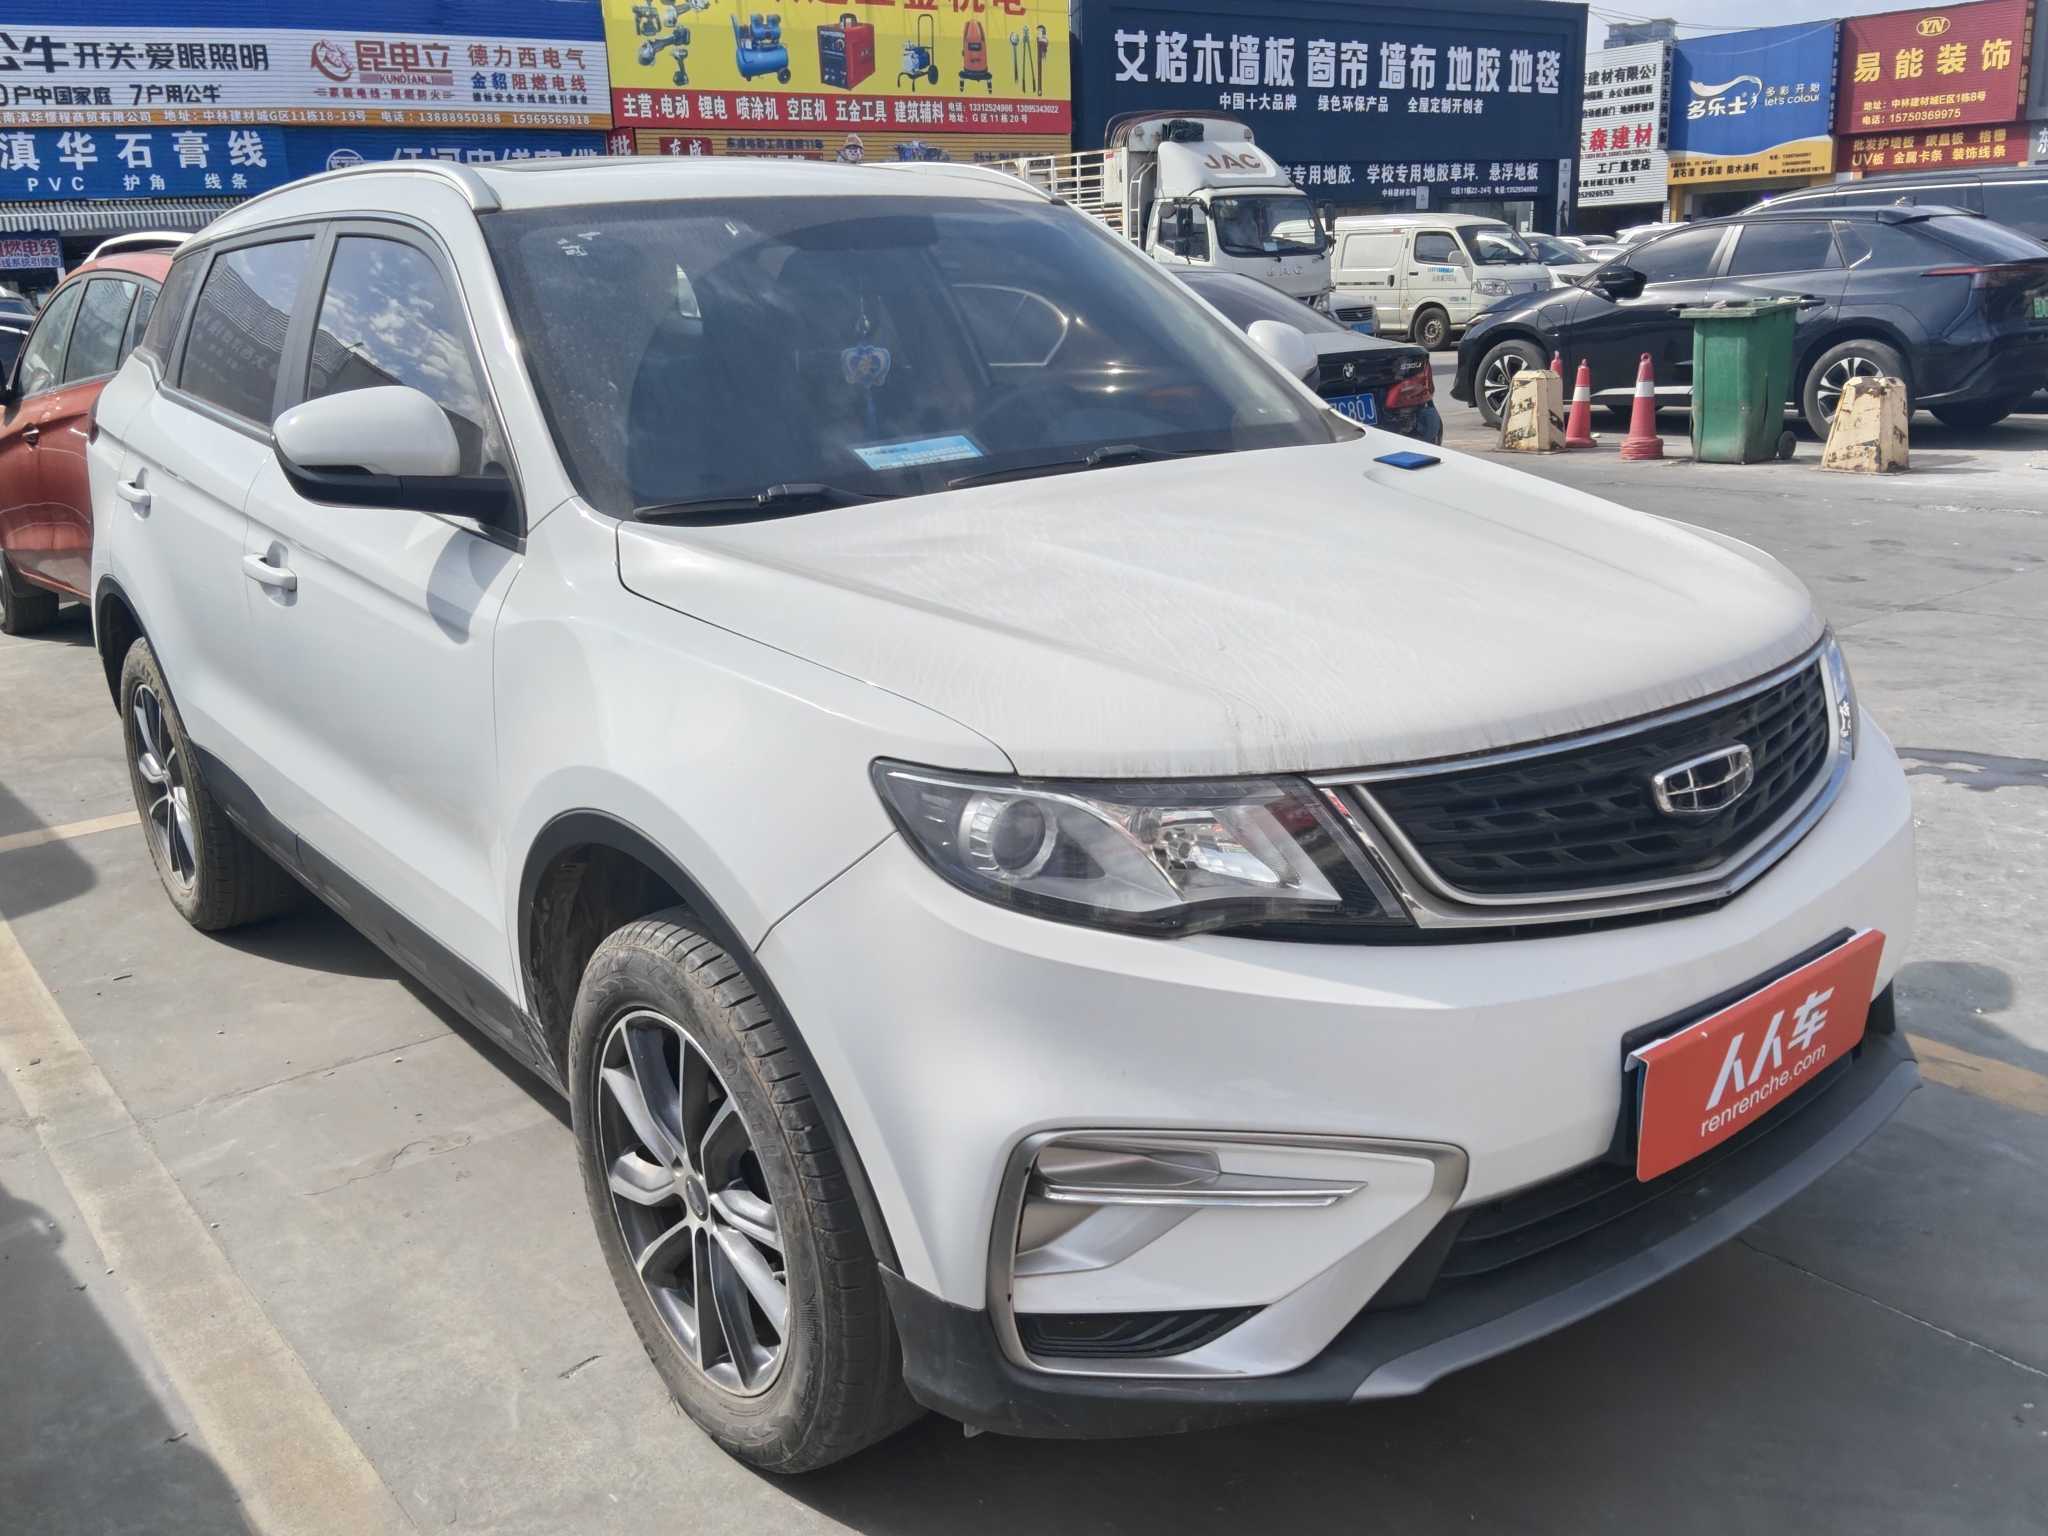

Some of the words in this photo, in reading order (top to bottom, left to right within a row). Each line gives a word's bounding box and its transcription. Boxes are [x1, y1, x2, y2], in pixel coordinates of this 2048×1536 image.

[355, 40, 453, 74] 昆电立
[467, 43, 586, 70] 德力西电气
[1114, 29, 1295, 87] 艾格木墙板
[1307, 38, 1368, 89] 窗帘
[1378, 41, 1436, 91] 墙布
[1446, 46, 1501, 93] 地胶
[1508, 49, 1560, 94] 地毯
[1853, 38, 2012, 83] 易能装饰
[698, 95, 728, 120] 锂电
[736, 96, 779, 120] 喷涂机
[786, 98, 828, 121] 空压机
[835, 99, 887, 123] 五金工具
[894, 100, 944, 124] 建筑辅料
[1219, 92, 1297, 111] 中国十大品牌
[1318, 95, 1389, 113] 绿色环保产品
[1407, 97, 1484, 114] 全屋定制开创者
[1686, 95, 1748, 120] 多乐士
[1581, 122, 1653, 151] 森建材
[0, 130, 267, 171] 滇华石膏线
[1204, 153, 1261, 169] JAC
[1852, 152, 1884, 166] UV板
[1894, 149, 1943, 164] 金属卡条
[1952, 145, 2006, 161] 装饰线条
[27, 177, 85, 192] PVC
[123, 174, 166, 191] 护角
[204, 172, 248, 190] 线条
[1489, 162, 1539, 182] 悬浮地板
[0, 239, 58, 257] 燃电线
[1329, 398, 1375, 422] C80J
[1705, 987, 1835, 1111] 人人车
[1700, 1044, 1826, 1137] renrenche.com
